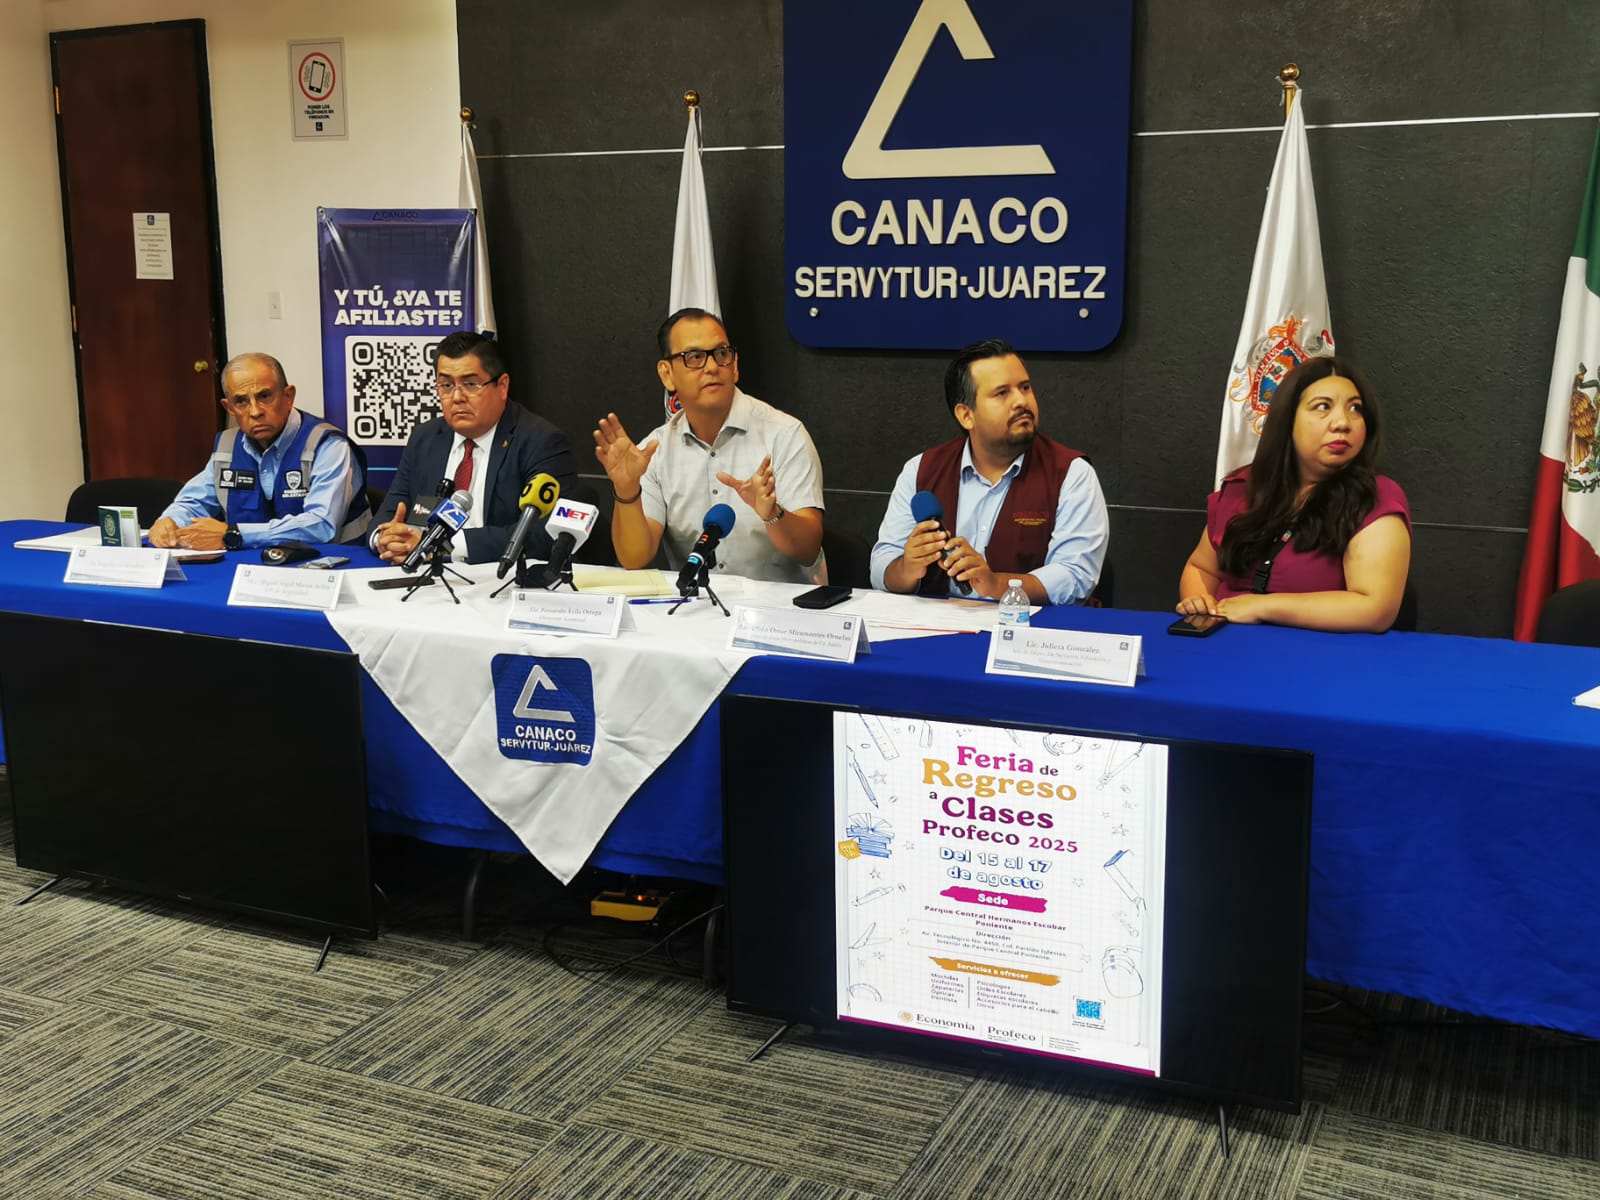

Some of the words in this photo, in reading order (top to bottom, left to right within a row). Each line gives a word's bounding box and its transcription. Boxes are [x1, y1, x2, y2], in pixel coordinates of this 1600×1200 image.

[383, 210, 418, 218] CANACO
[831, 197, 1068, 245] CANACO
[334, 289, 349, 306] Y
[353, 285, 388, 309] TÚ,
[393, 290, 431, 307] ¿YA
[435, 290, 462, 306] TE
[334, 309, 463, 326] AFILIASTE?
[539, 482, 557, 505] 6
[556, 506, 590, 521] NET
[515, 725, 576, 741] CANACO
[957, 746, 1034, 773] Feria
[1040, 765, 1058, 776] de
[922, 758, 1077, 801] Regreso
[929, 792, 938, 800] a
[941, 796, 1054, 829] Clases
[922, 819, 1020, 846] Profeco
[1028, 836, 1078, 853] 2025
[940, 847, 971, 863] Del
[977, 852, 999, 866] 15
[1004, 857, 1023, 870] al
[1029, 859, 1053, 873] 17
[947, 866, 972, 881] de
[976, 871, 1044, 890] agosto
[977, 893, 1009, 905] Sede
[924, 905, 954, 914] Parque
[956, 909, 986, 919] Central
[988, 914, 1031, 926] Hermanos
[1033, 921, 1067, 931] Escobar
[976, 920, 1014, 931] Poniente
[987, 1025, 1036, 1042] Profeco
